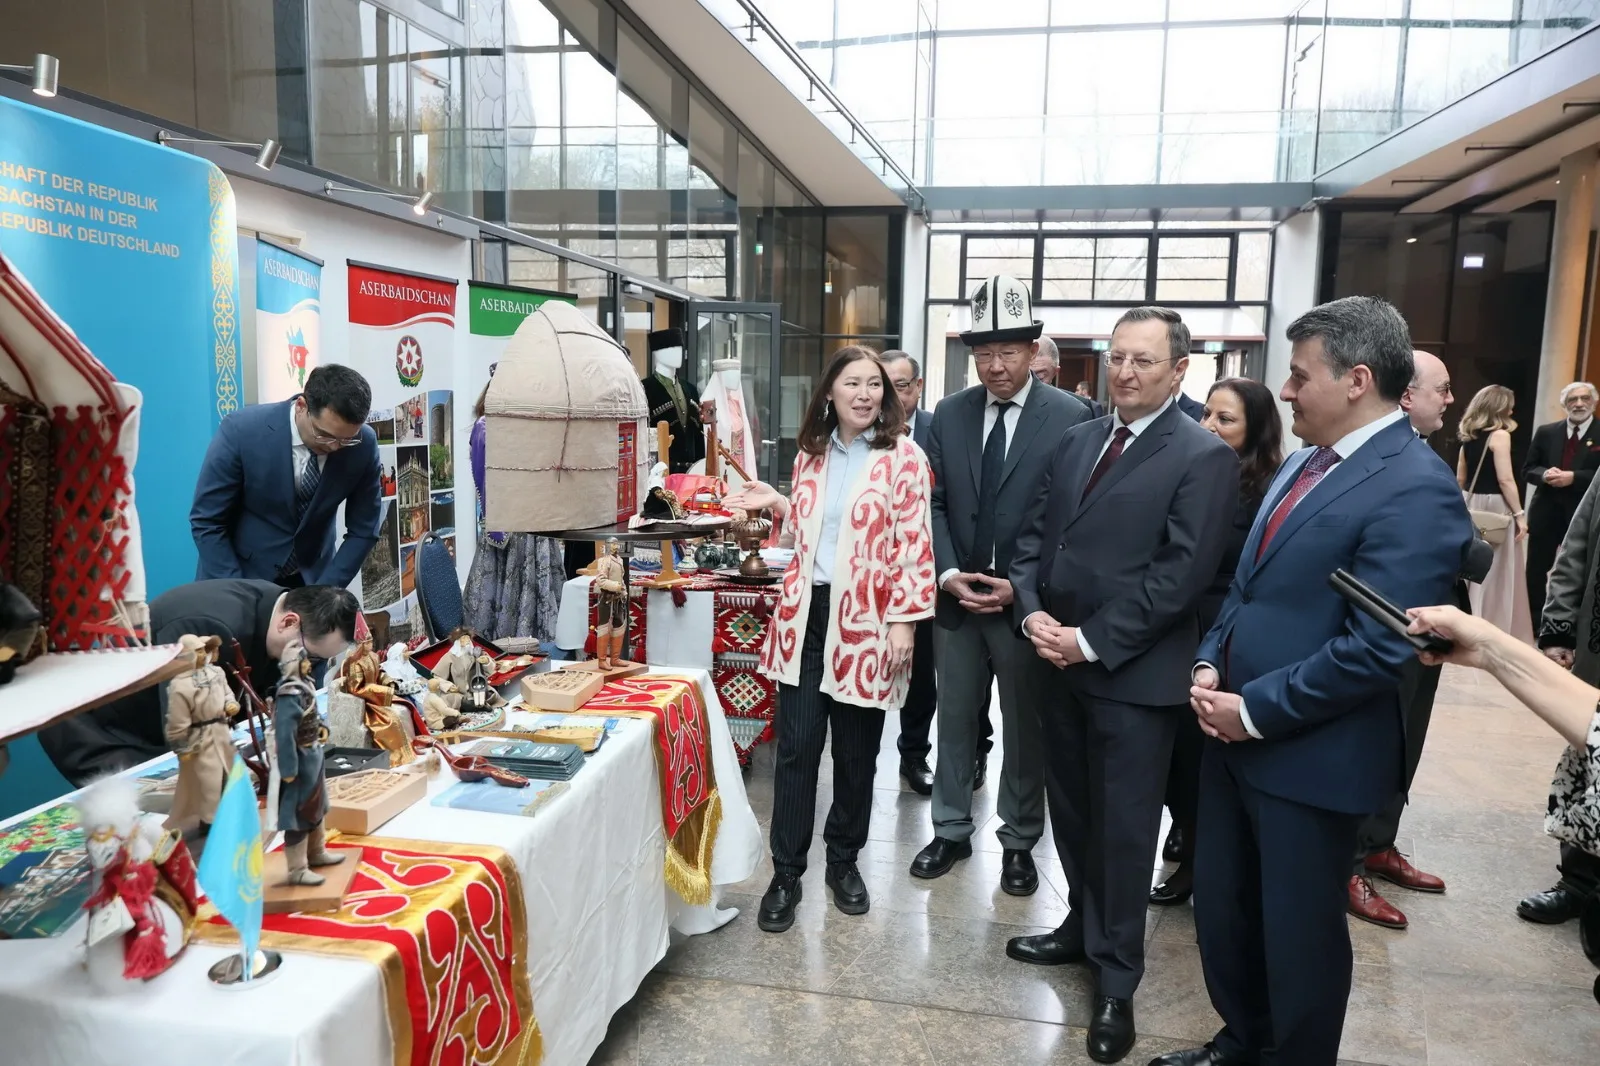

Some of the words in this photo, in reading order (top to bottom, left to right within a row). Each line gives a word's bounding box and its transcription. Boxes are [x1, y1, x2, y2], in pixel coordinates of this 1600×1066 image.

[51, 173, 84, 195] DER
[88, 182, 158, 212] REPUBLIK
[90, 205, 104, 222] IN
[108, 209, 137, 229] DER
[0, 211, 73, 239] EPUBLIK
[77, 226, 180, 258] DEUTSCHLAND
[264, 257, 319, 289] ASERBAIDSCHAN
[359, 280, 451, 307] ASERBAIDSCHAN
